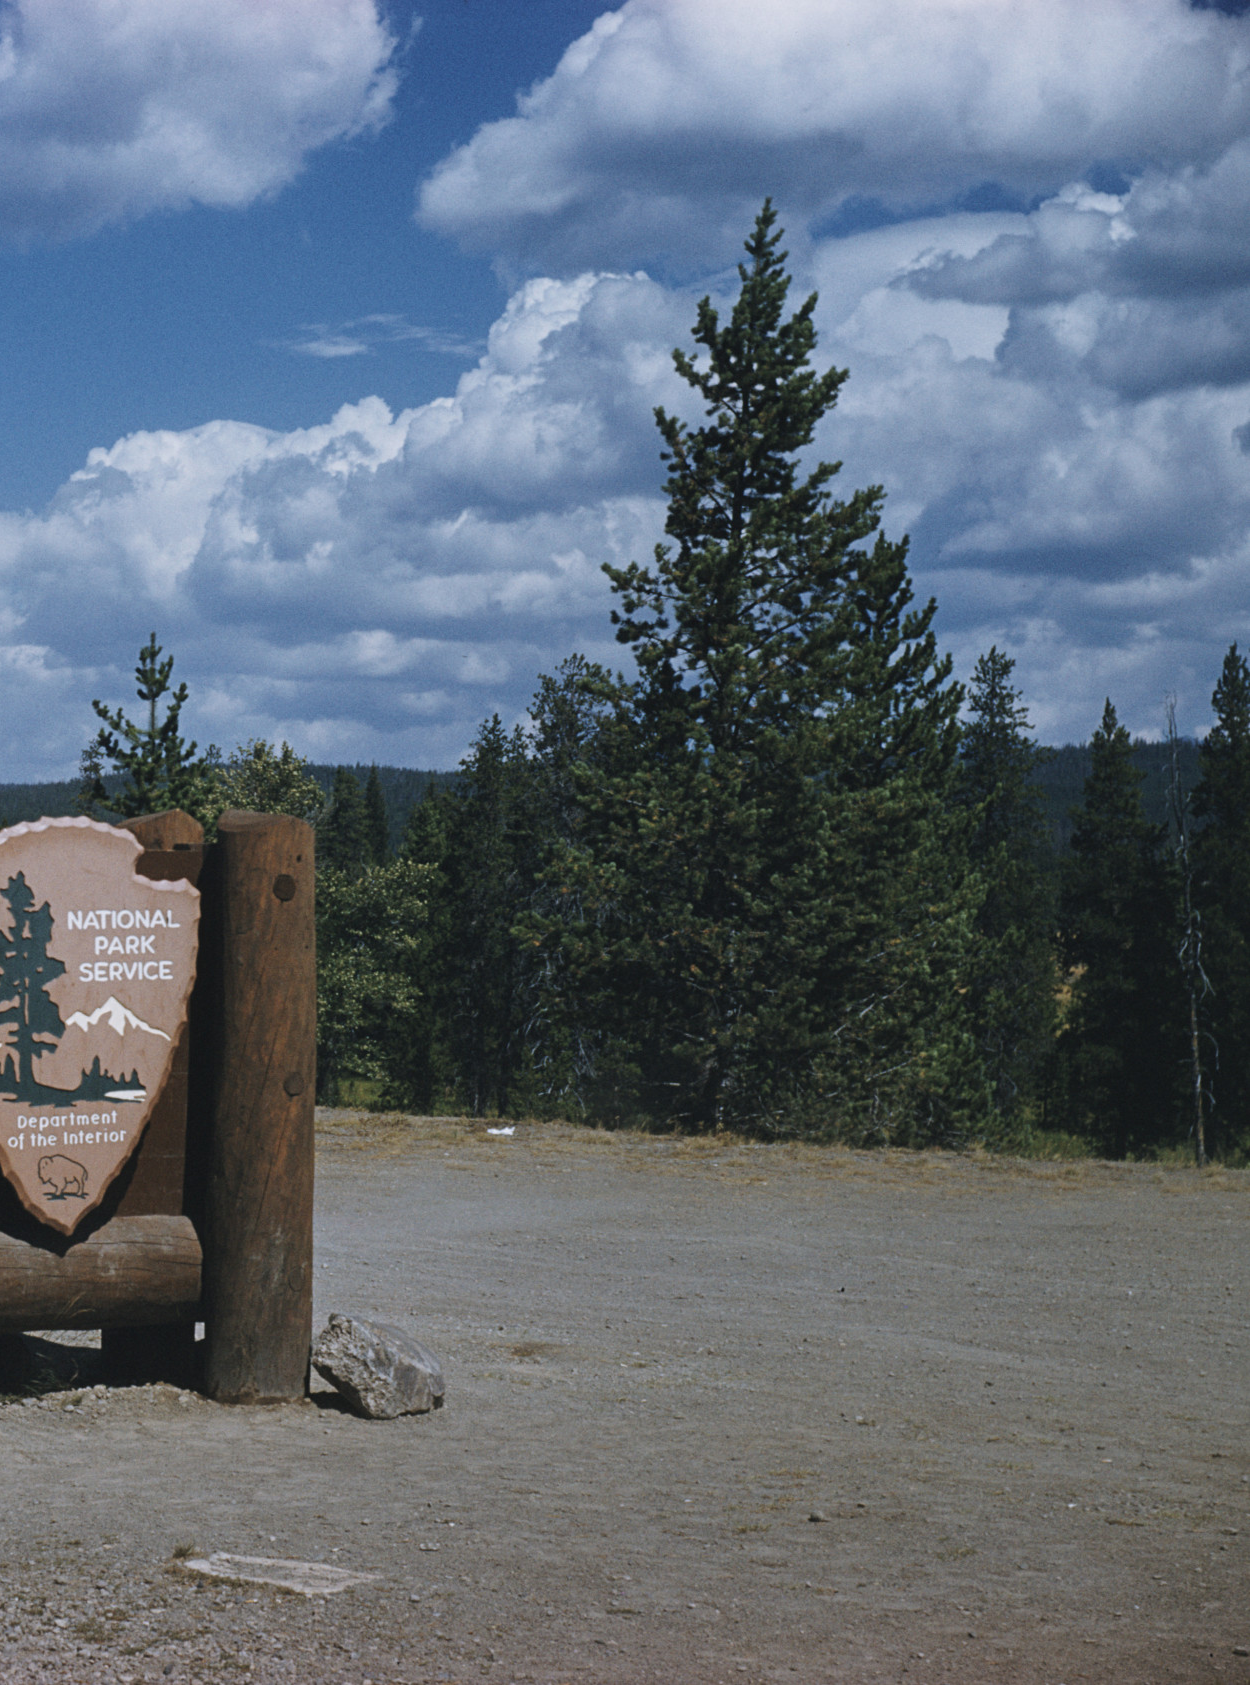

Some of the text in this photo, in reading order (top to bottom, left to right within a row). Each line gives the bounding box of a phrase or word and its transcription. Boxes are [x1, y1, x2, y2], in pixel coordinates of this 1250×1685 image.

[67, 909, 180, 930] NATIONAL
[94, 934, 156, 955] PARK
[79, 961, 173, 982] SERVICE
[17, 1110, 118, 1131] Department
[7, 1128, 127, 1150] of the Interior
